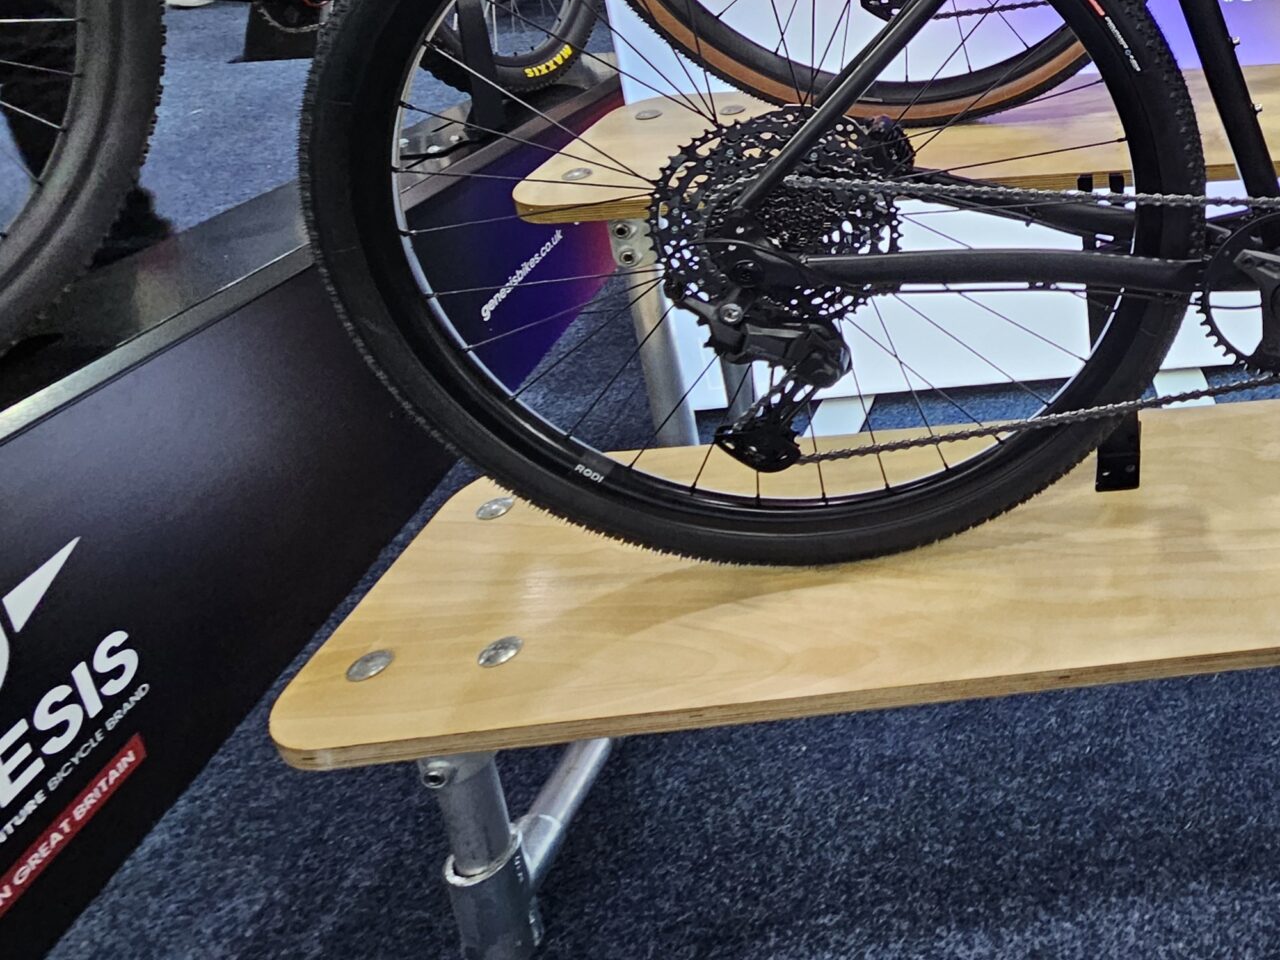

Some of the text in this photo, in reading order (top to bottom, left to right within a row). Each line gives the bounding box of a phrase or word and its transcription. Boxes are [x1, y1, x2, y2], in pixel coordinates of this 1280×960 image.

[524, 43, 573, 78] MAXXIS
[480, 228, 564, 322] genesisbikes.co.uk
[574, 463, 605, 484] RODI
[46, 728, 106, 792] BICYCLE
[104, 682, 151, 732] BRAND
[12, 818, 72, 886] GREAT
[72, 749, 137, 822] BRITAIN
